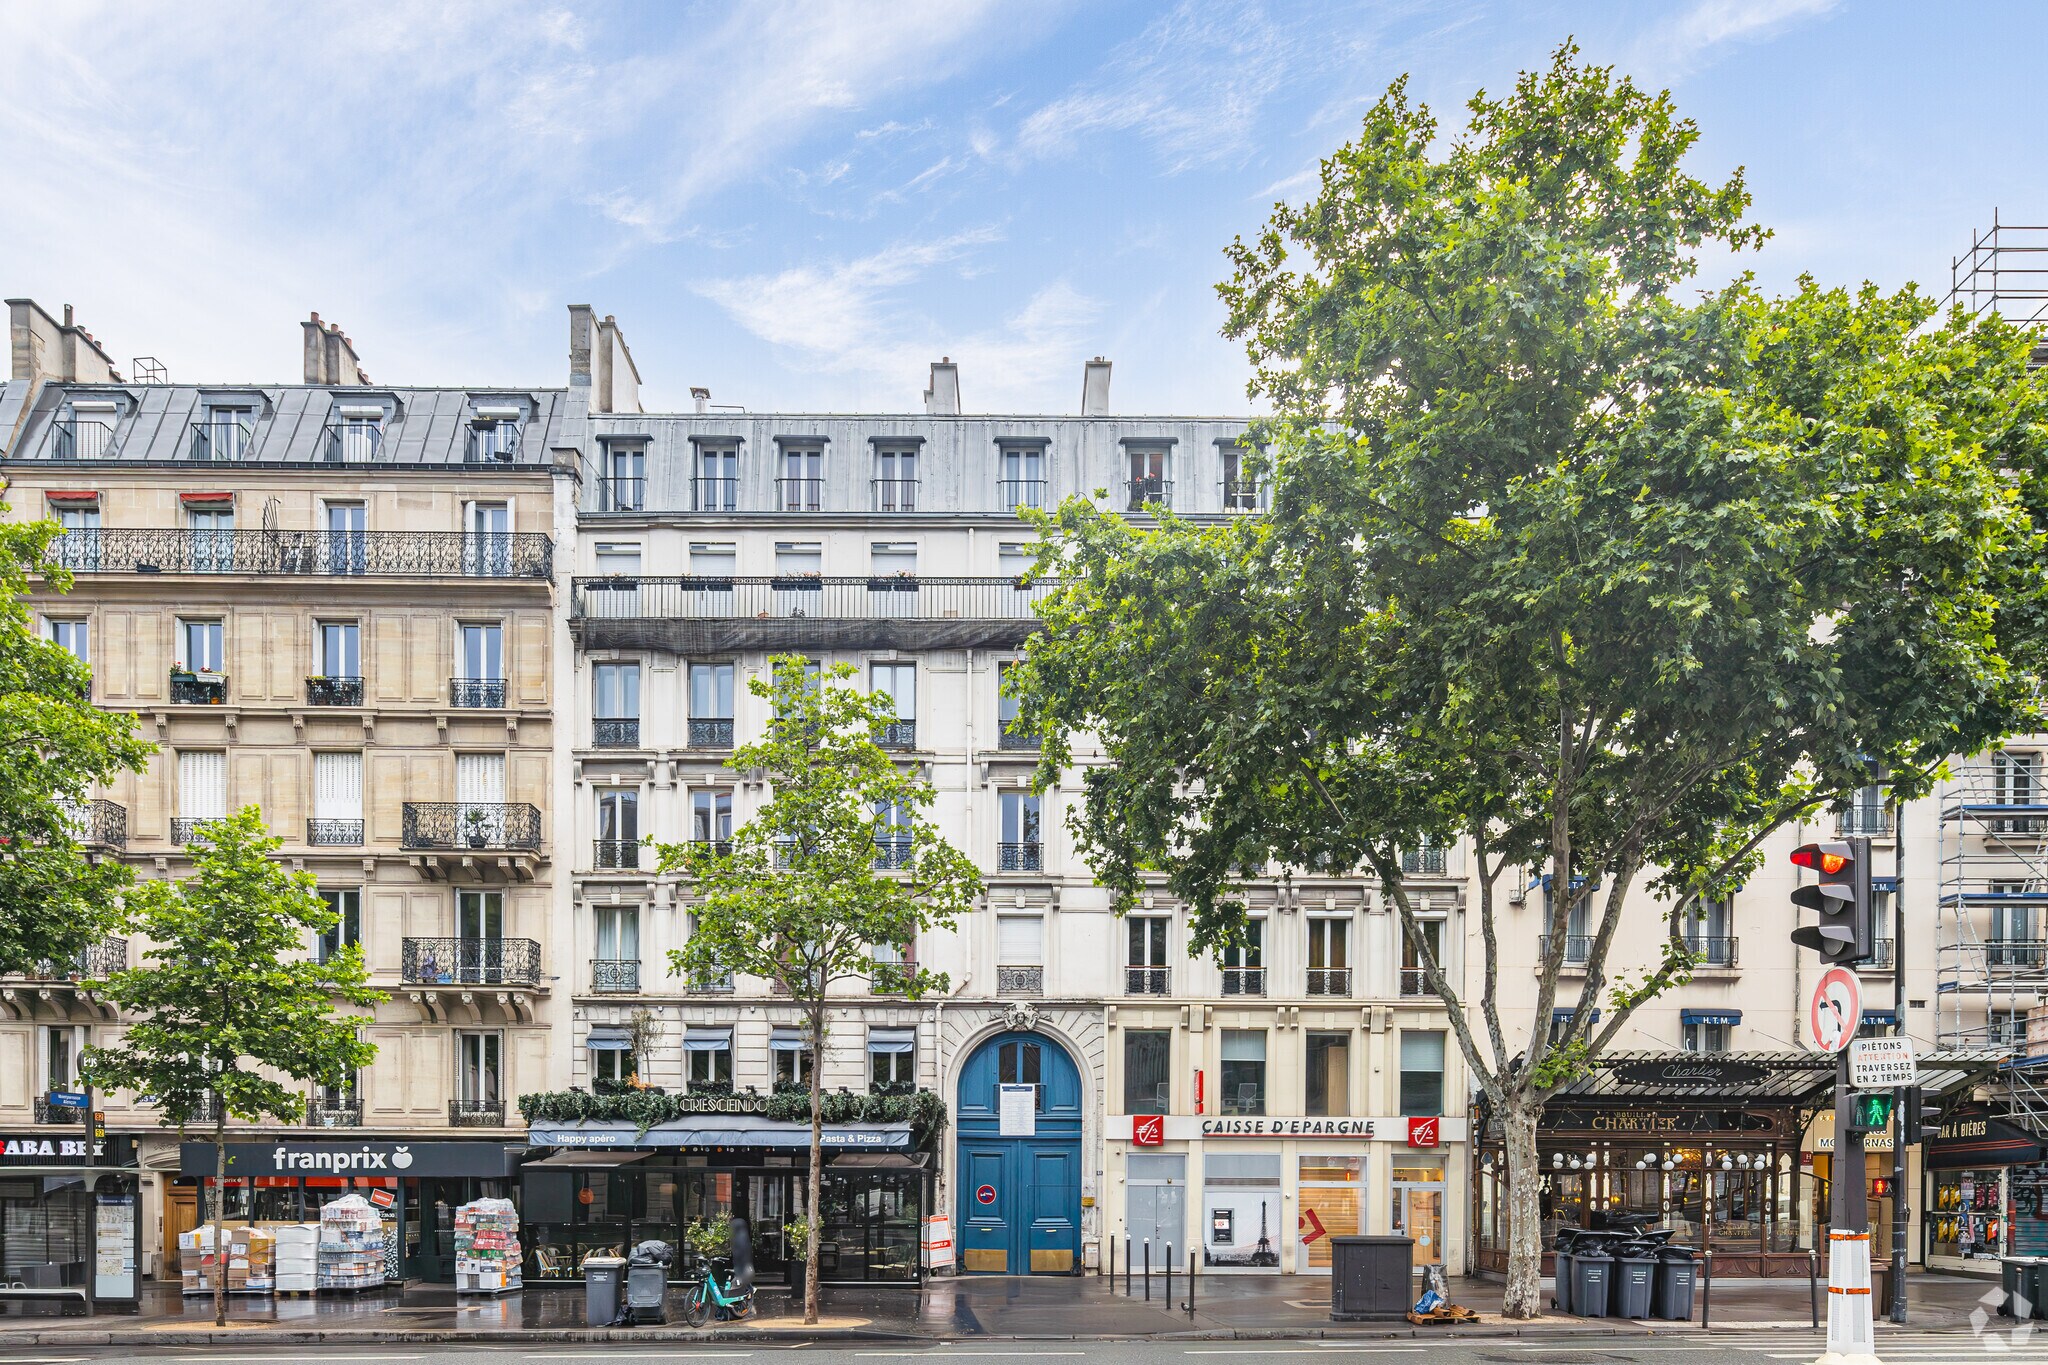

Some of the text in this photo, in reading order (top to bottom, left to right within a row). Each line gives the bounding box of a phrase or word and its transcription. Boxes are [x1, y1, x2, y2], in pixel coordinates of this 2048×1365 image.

[1861, 1041, 1902, 1051] PIÉTONS
[1857, 1052, 1908, 1062] ATTENTION
[1856, 1062, 1911, 1072] TRAVERSEZ
[1662, 1064, 1723, 1083] Chartier
[1857, 1073, 1912, 1083] EN 2 TEMPS
[679, 1098, 768, 1112] CRESCENDO
[1202, 1120, 1375, 1134] CAISSE D'EPARGNE
[1592, 1116, 1677, 1130] CHARTIER
[1952, 1121, 1958, 1138] À
[1960, 1119, 1987, 1137] BIÈRES
[557, 1134, 616, 1144] Happy apéro
[820, 1134, 882, 1143] Pasta & Pizza
[273, 1146, 387, 1173] franprix
